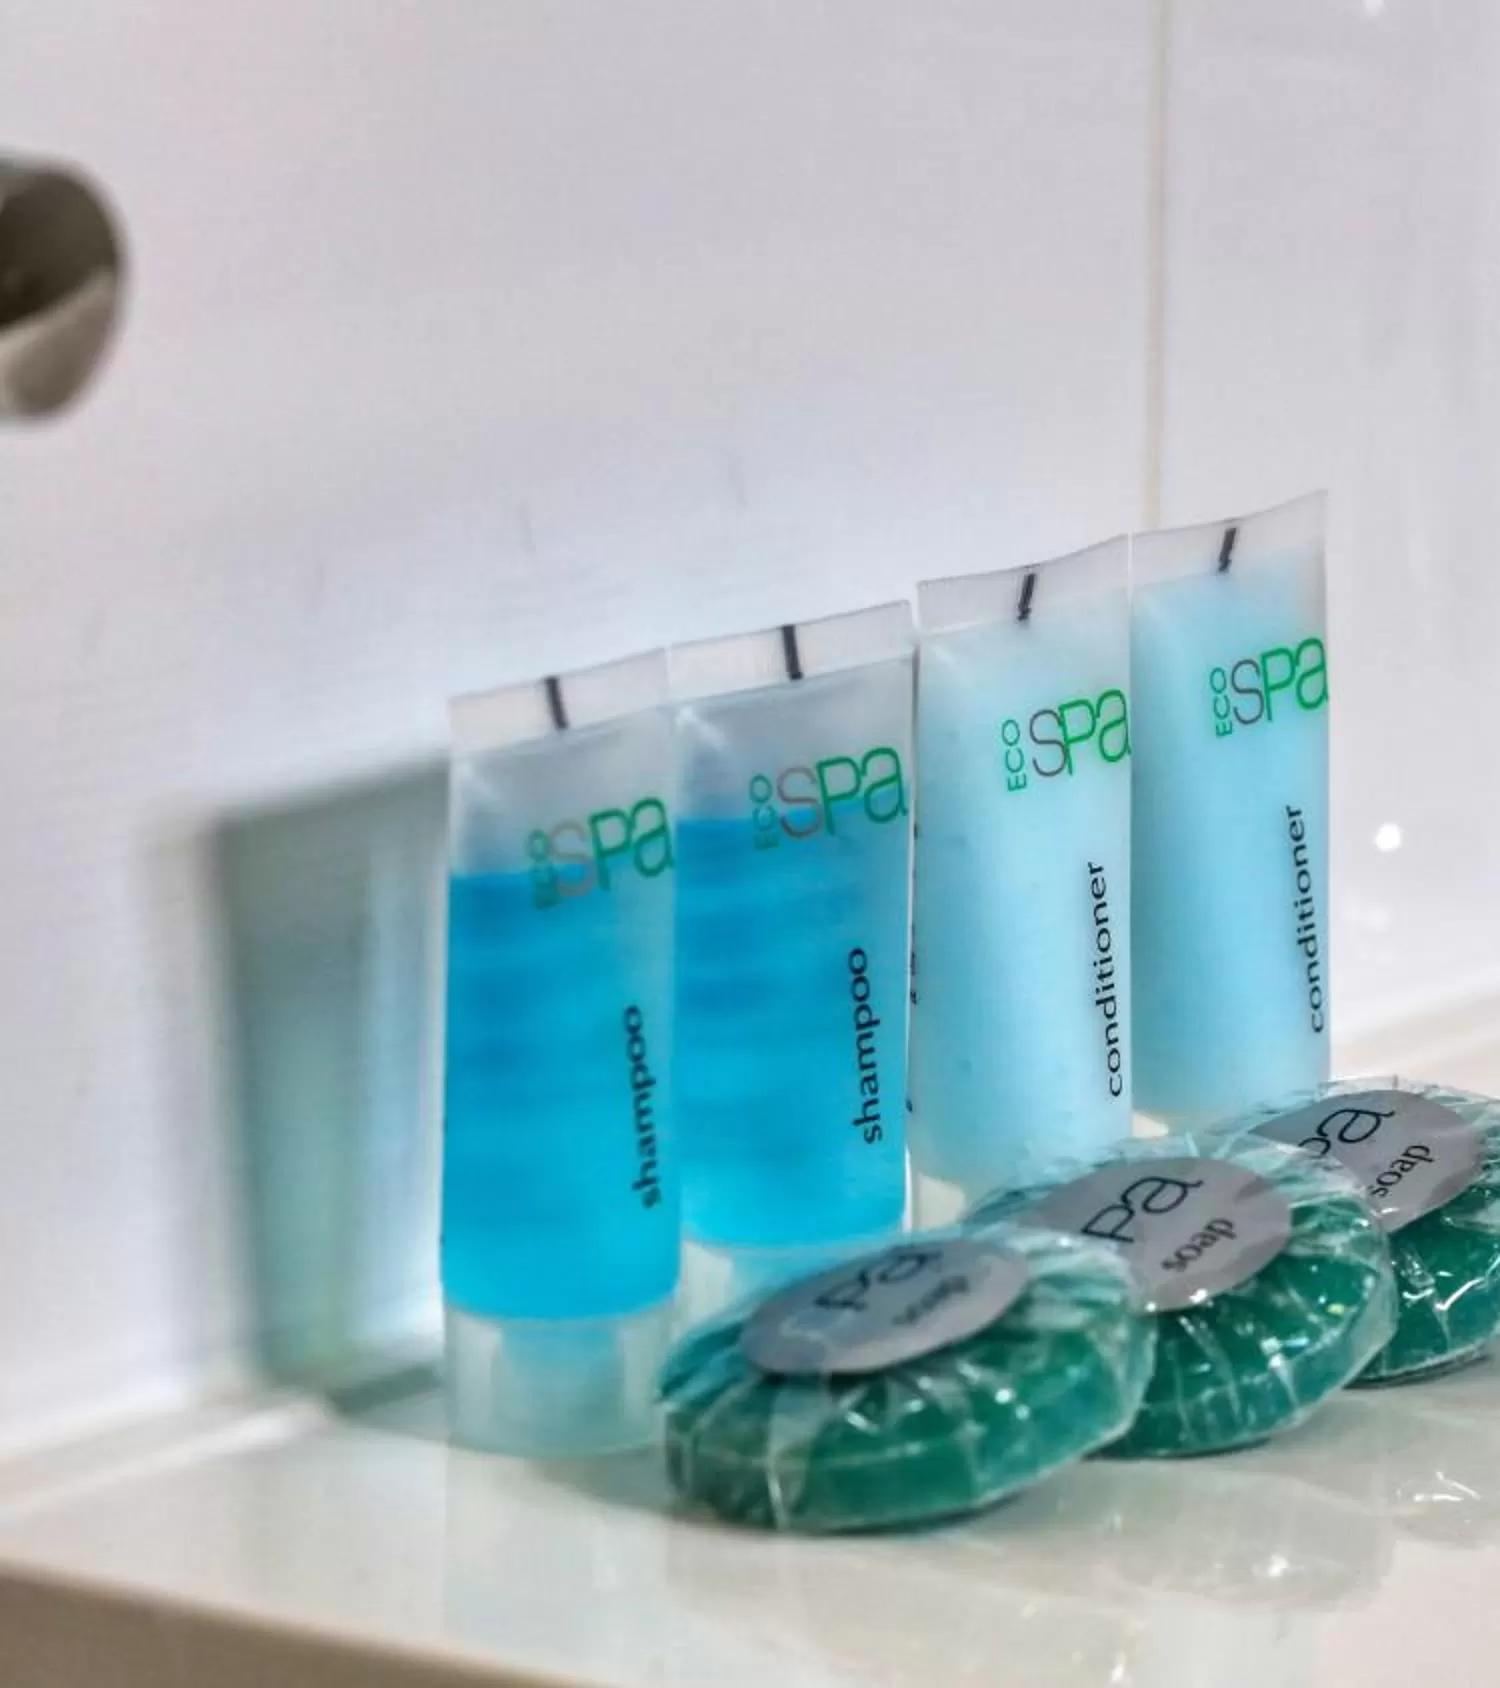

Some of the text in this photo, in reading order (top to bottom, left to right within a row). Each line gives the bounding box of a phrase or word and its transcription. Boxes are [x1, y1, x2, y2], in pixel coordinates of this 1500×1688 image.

[1001, 719, 1027, 792] ECO
[1209, 667, 1233, 738] ECO
[1089, 861, 1123, 1098] conditioner
[1287, 804, 1324, 1033] conditioner
[624, 1005, 659, 1208] shampoo
[848, 946, 882, 1144] shampoo
[1368, 1145, 1435, 1198] soap
[1161, 1217, 1237, 1273] soap
